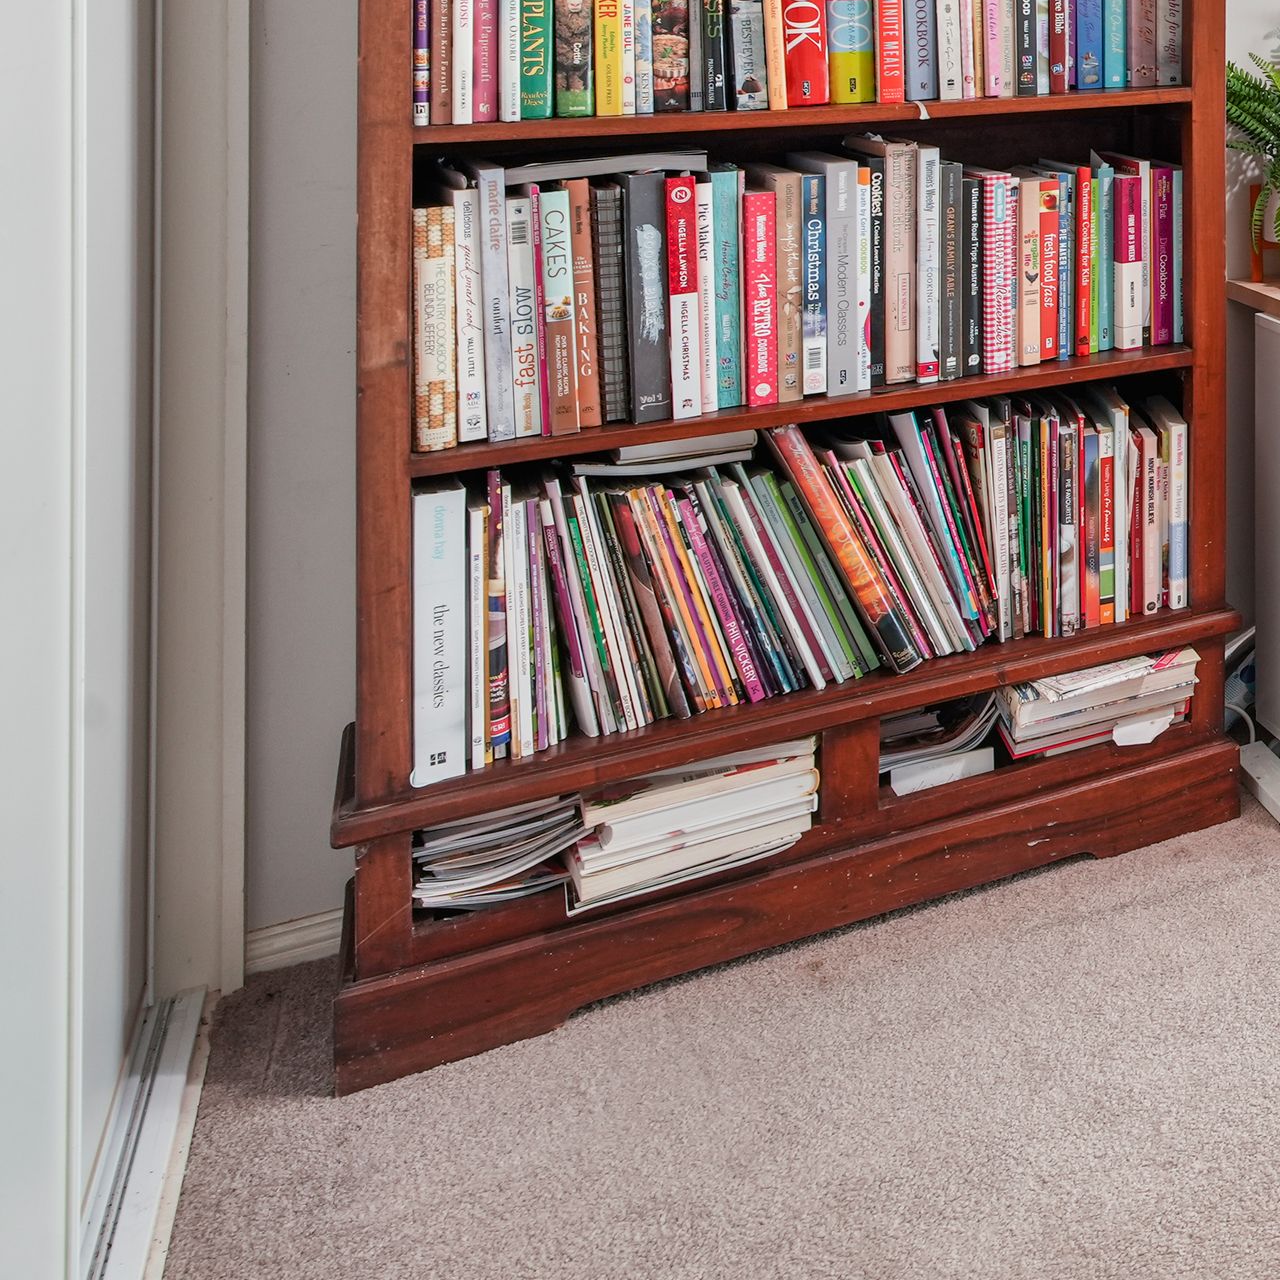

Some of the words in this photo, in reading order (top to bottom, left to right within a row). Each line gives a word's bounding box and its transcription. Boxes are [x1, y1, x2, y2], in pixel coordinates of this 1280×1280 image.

[623, 3, 632, 28] JANE
[1055, 10, 1065, 35] Bible
[478, 24, 493, 83] Papercraft
[522, 0, 546, 77] PLANTS
[623, 29, 632, 55] BULL
[884, 39, 901, 78] MEALS
[925, 159, 937, 188] Women's
[489, 179, 500, 215] marie
[698, 202, 710, 222] Pie
[871, 172, 883, 218] Cookies!
[923, 188, 936, 213] Weekly
[971, 187, 980, 222] Ultimate
[1081, 181, 1091, 221] Christmas
[464, 200, 472, 241] delicious.
[490, 216, 501, 251] claire
[679, 218, 690, 253] NIGELLA
[946, 206, 956, 239] GRAN'S
[971, 223, 979, 242] Road
[1058, 228, 1067, 243] PIE
[1081, 222, 1091, 251] Cooking
[544, 209, 568, 279] CAKES
[698, 223, 710, 262] Maker
[807, 218, 823, 301] Christmas
[946, 241, 956, 272] FAMILY
[970, 243, 980, 263] Trips:
[995, 228, 1005, 270] RECIPES
[1043, 233, 1056, 260] fresh
[1081, 252, 1090, 263] for
[679, 253, 690, 288] LAWSON
[758, 272, 775, 298] The
[837, 254, 849, 297] Modern
[946, 273, 956, 297] TABLE
[971, 264, 979, 296] Australia
[995, 272, 1004, 285] TO
[1044, 261, 1056, 287] food
[1081, 264, 1090, 287] Kids
[425, 282, 435, 321] BELINDA
[512, 286, 533, 338] slow
[1044, 287, 1057, 309] fast
[493, 297, 504, 336] comfort
[681, 300, 690, 335] NIGELLA
[753, 298, 771, 338] RETRO
[837, 298, 850, 347] Classics
[995, 285, 1007, 347] Remember
[426, 322, 437, 358] JEFFERY
[577, 292, 592, 378] BAKING
[514, 343, 536, 388] fast
[682, 336, 692, 381] CHRISTMAS
[756, 338, 769, 375] COOKBOOK
[1147, 457, 1155, 476] MOVE
[1147, 477, 1155, 503] NOURISH
[1147, 503, 1155, 527] BELIEVE
[433, 604, 450, 628] the
[433, 632, 447, 658] new
[726, 619, 741, 644] PHIL
[734, 641, 758, 684] VICKERY
[433, 659, 450, 709] classics
